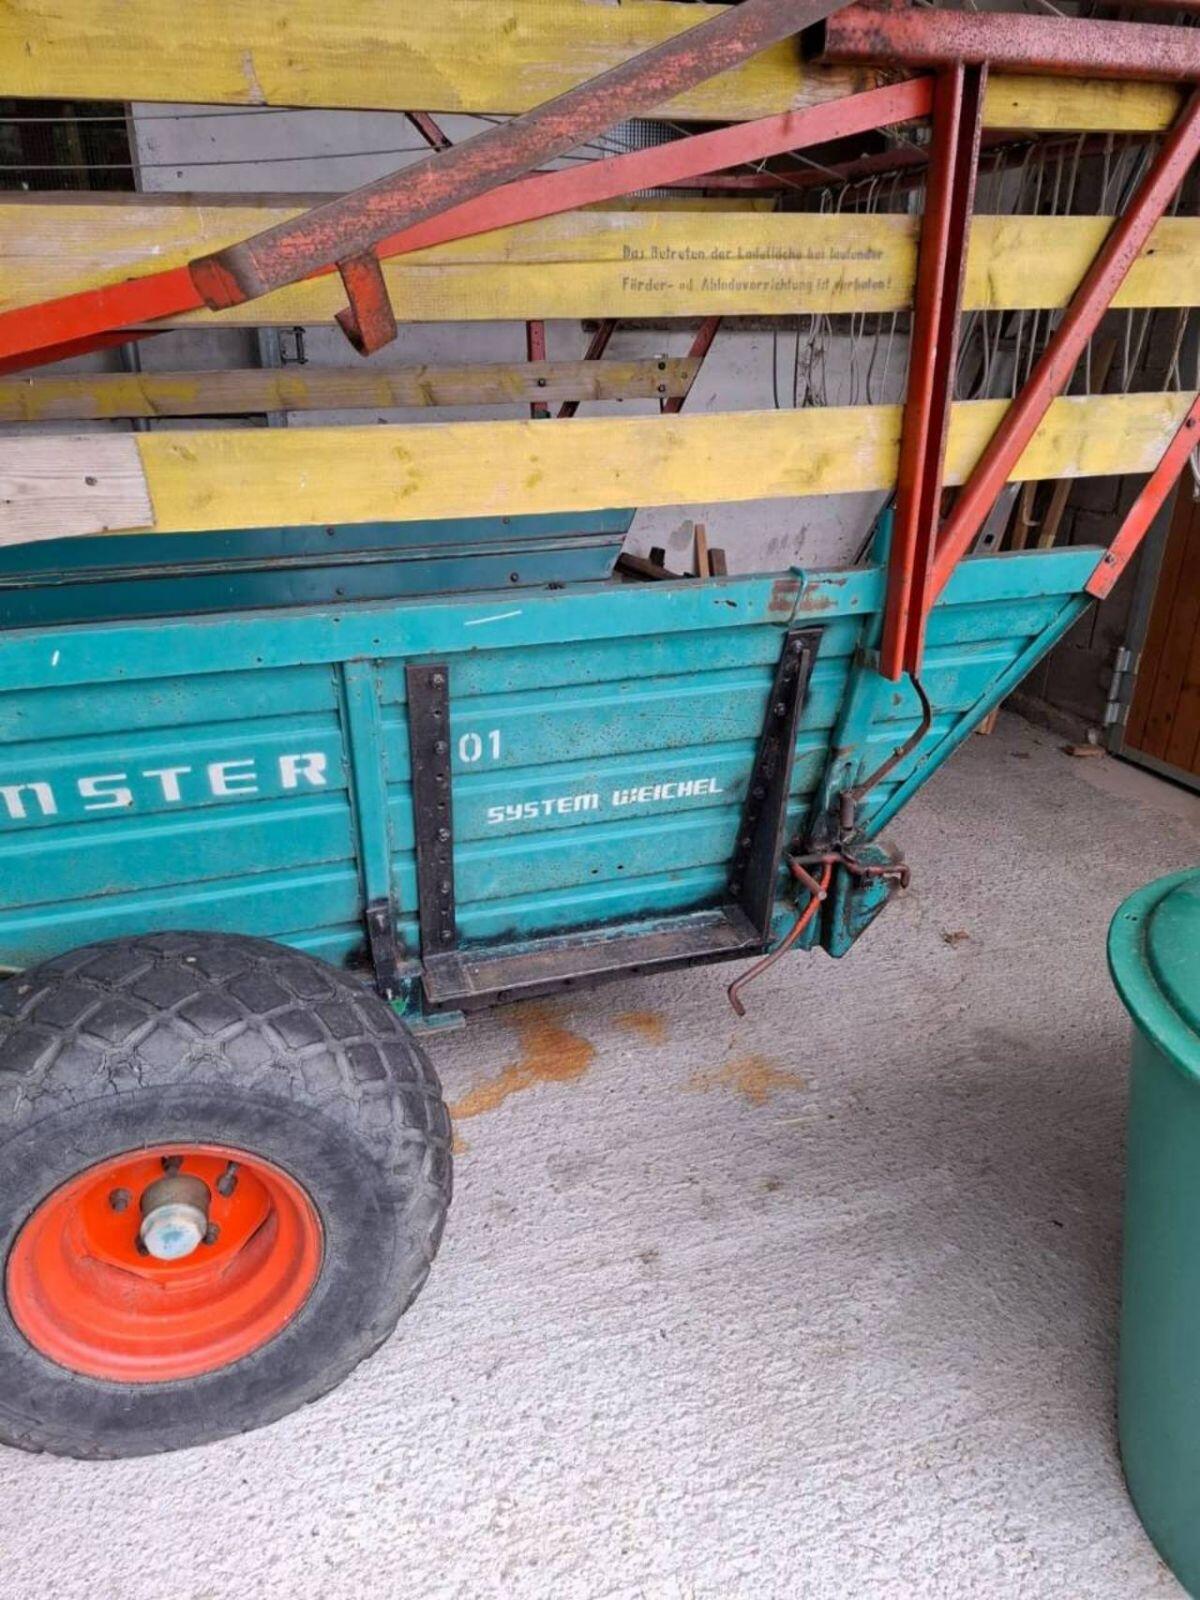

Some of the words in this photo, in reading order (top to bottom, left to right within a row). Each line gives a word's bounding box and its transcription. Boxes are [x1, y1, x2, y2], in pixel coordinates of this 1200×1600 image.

[622, 244, 645, 260] Das
[651, 245, 705, 260] Betreten
[711, 245, 732, 260] der
[622, 276, 673, 291] Förder-
[458, 729, 501, 763] 01
[487, 793, 600, 825] SYSTEM
[612, 777, 724, 806] WEICHEL
